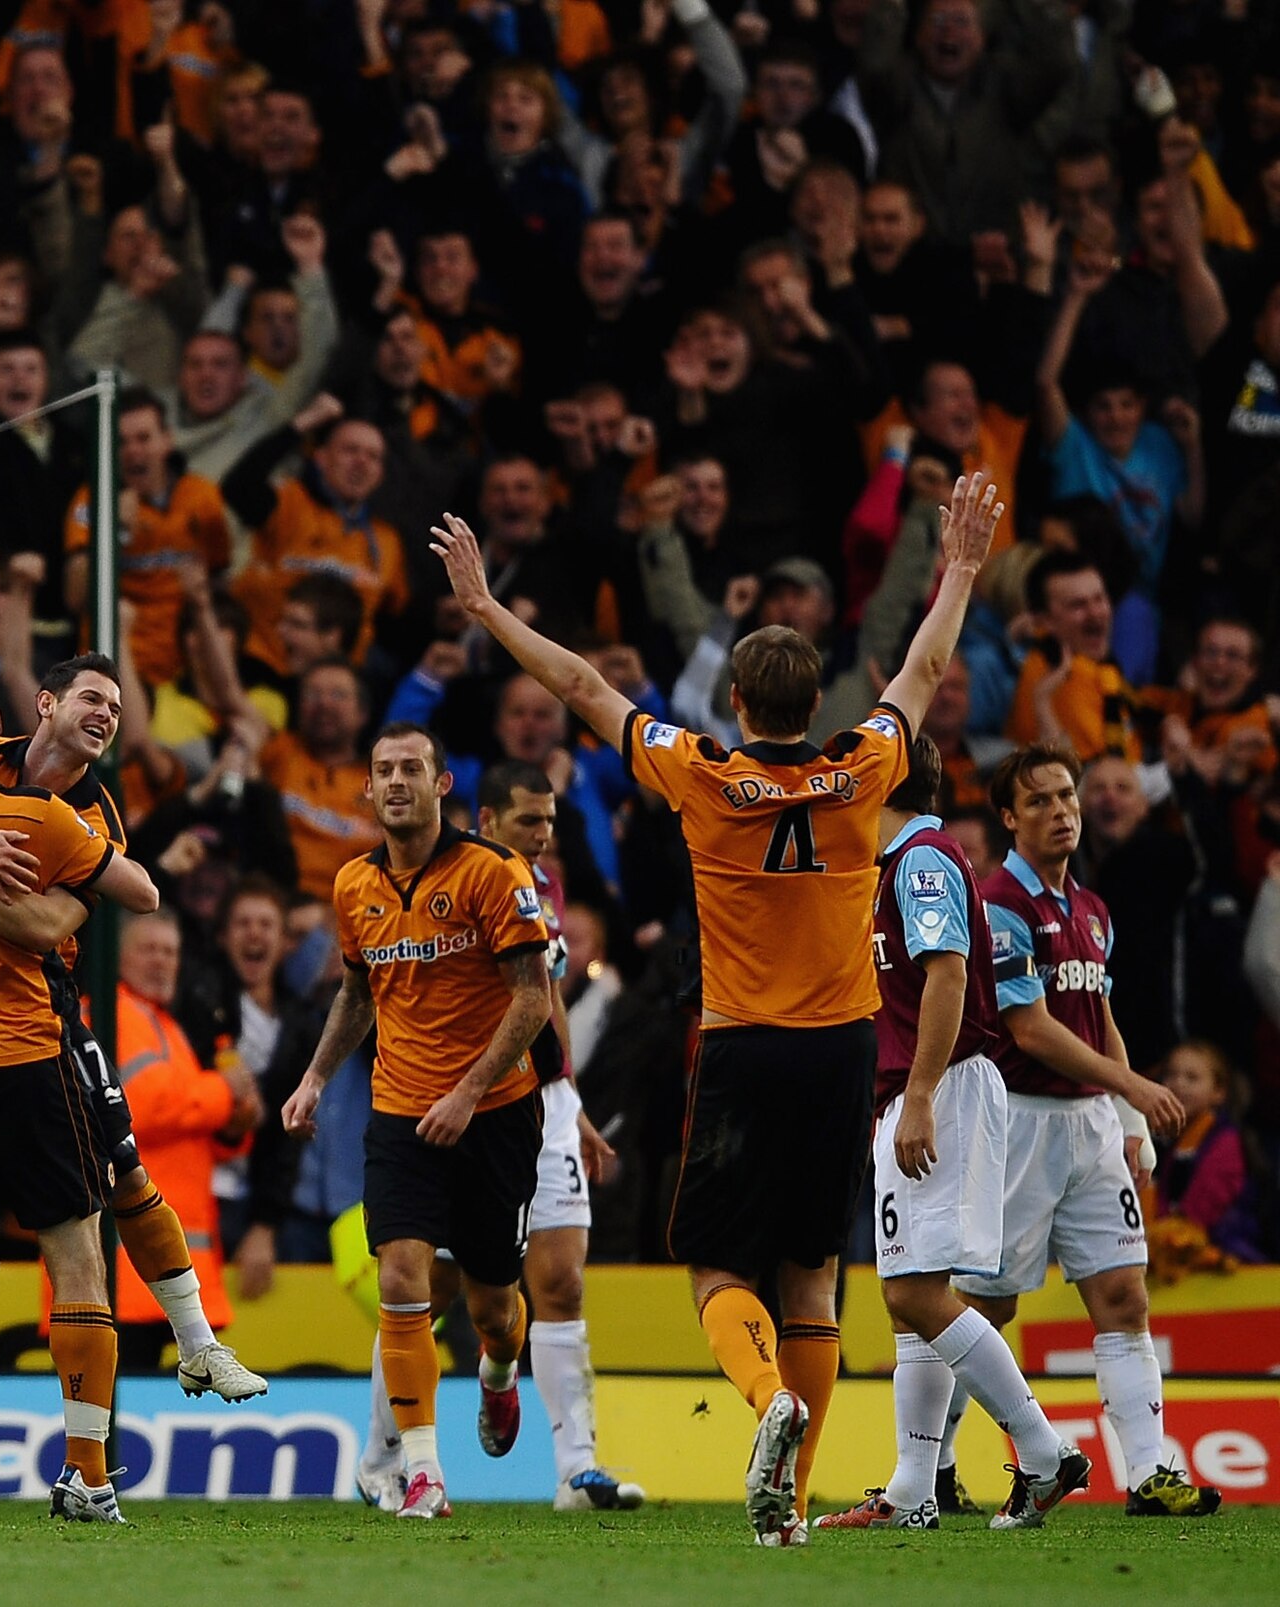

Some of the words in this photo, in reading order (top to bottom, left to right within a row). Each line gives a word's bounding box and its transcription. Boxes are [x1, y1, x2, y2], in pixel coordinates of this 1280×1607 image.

[720, 771, 861, 811] EDWRDS
[762, 802, 827, 874] 4
[565, 1155, 582, 1194] 3
[1118, 1188, 1140, 1230] 8
